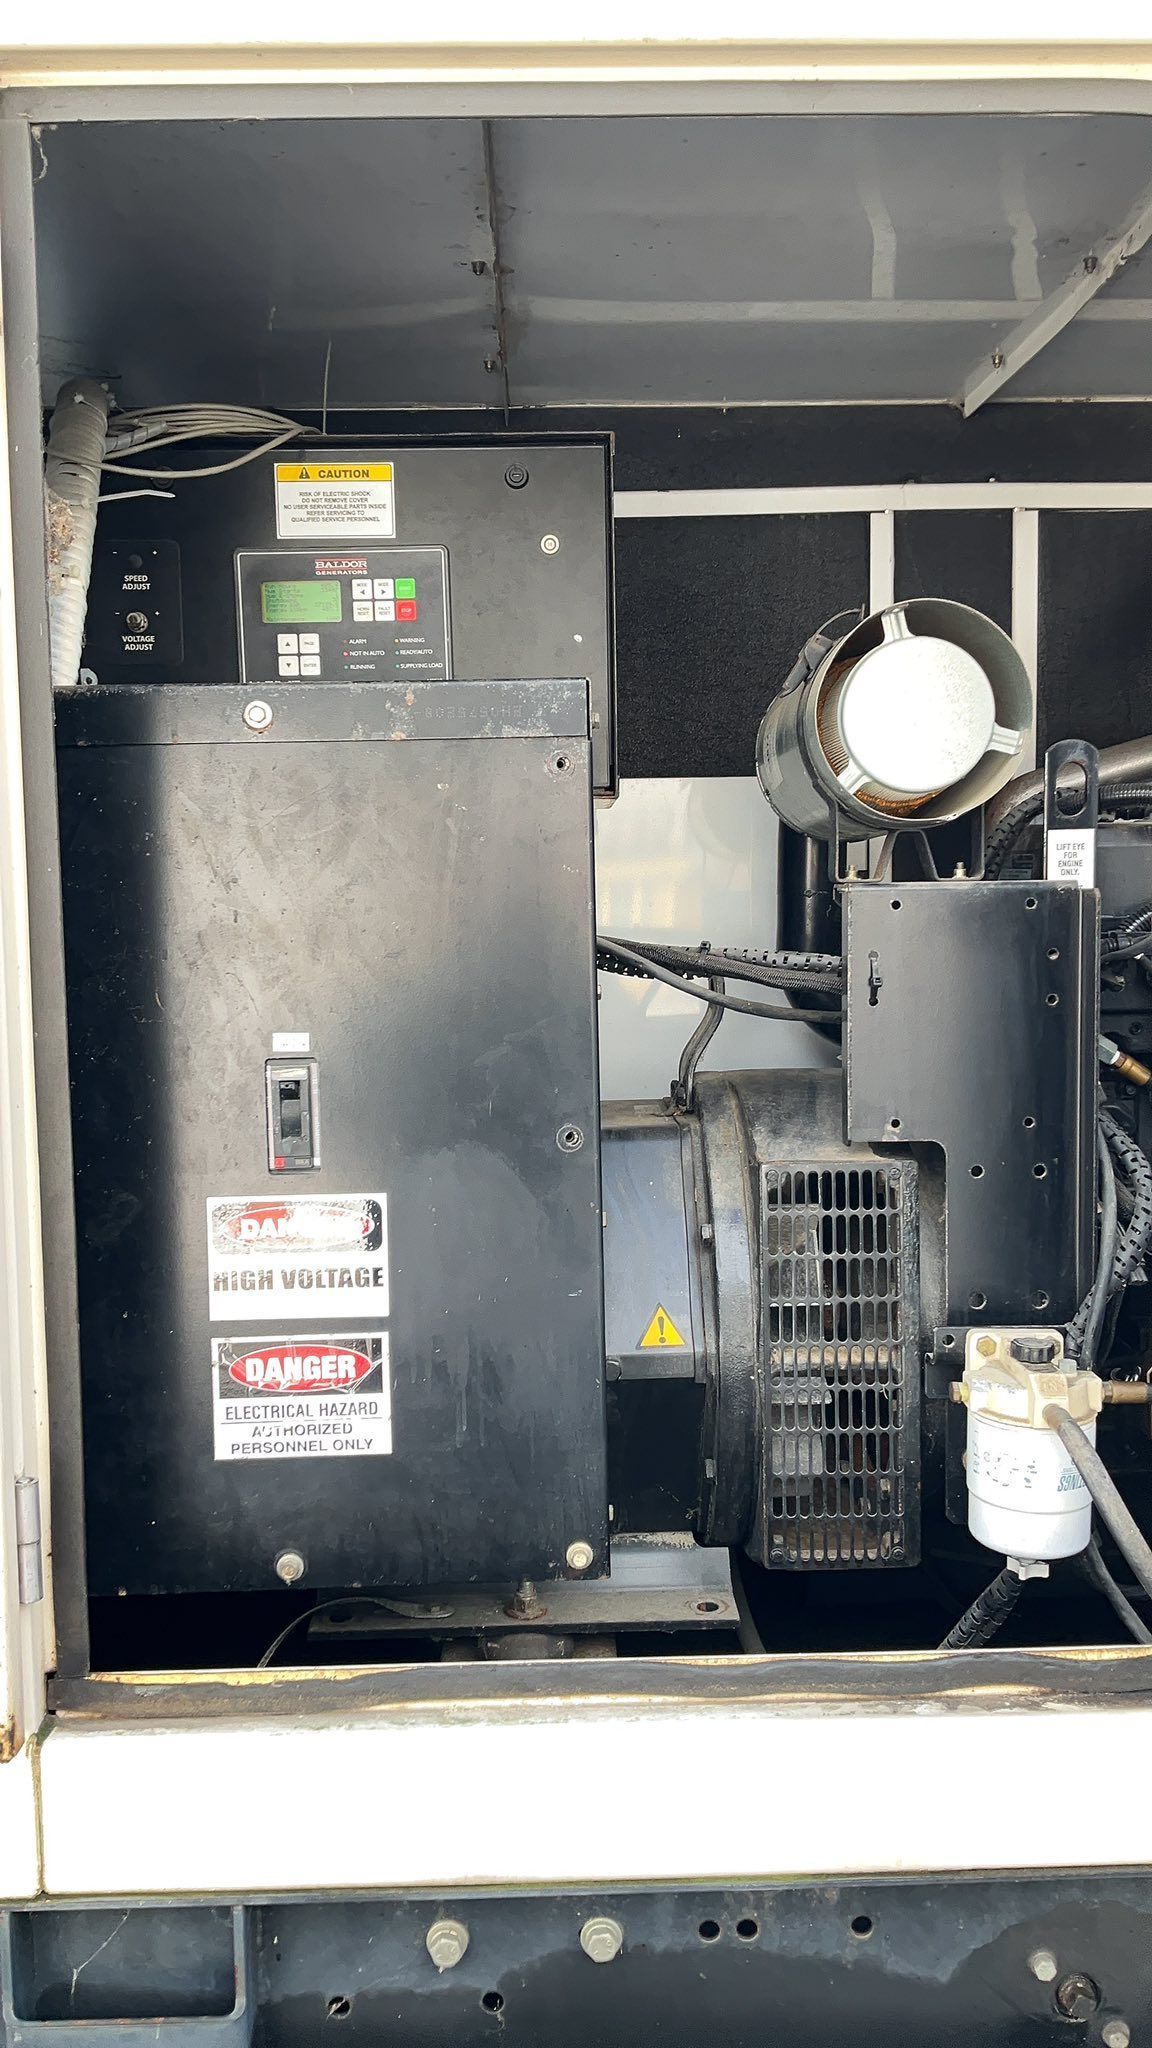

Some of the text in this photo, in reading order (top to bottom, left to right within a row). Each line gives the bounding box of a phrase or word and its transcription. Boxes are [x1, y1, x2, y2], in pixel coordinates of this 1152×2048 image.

[319, 470, 369, 478] CAUTION
[213, 1267, 384, 1291] HIGH VOLTAGE
[246, 1355, 357, 1382] DANGER
[225, 1401, 378, 1420] ELECTRICAL HAZARD
[252, 1423, 353, 1438] AUTHORIZED
[231, 1439, 373, 1454] PERSONNEL ONLY
